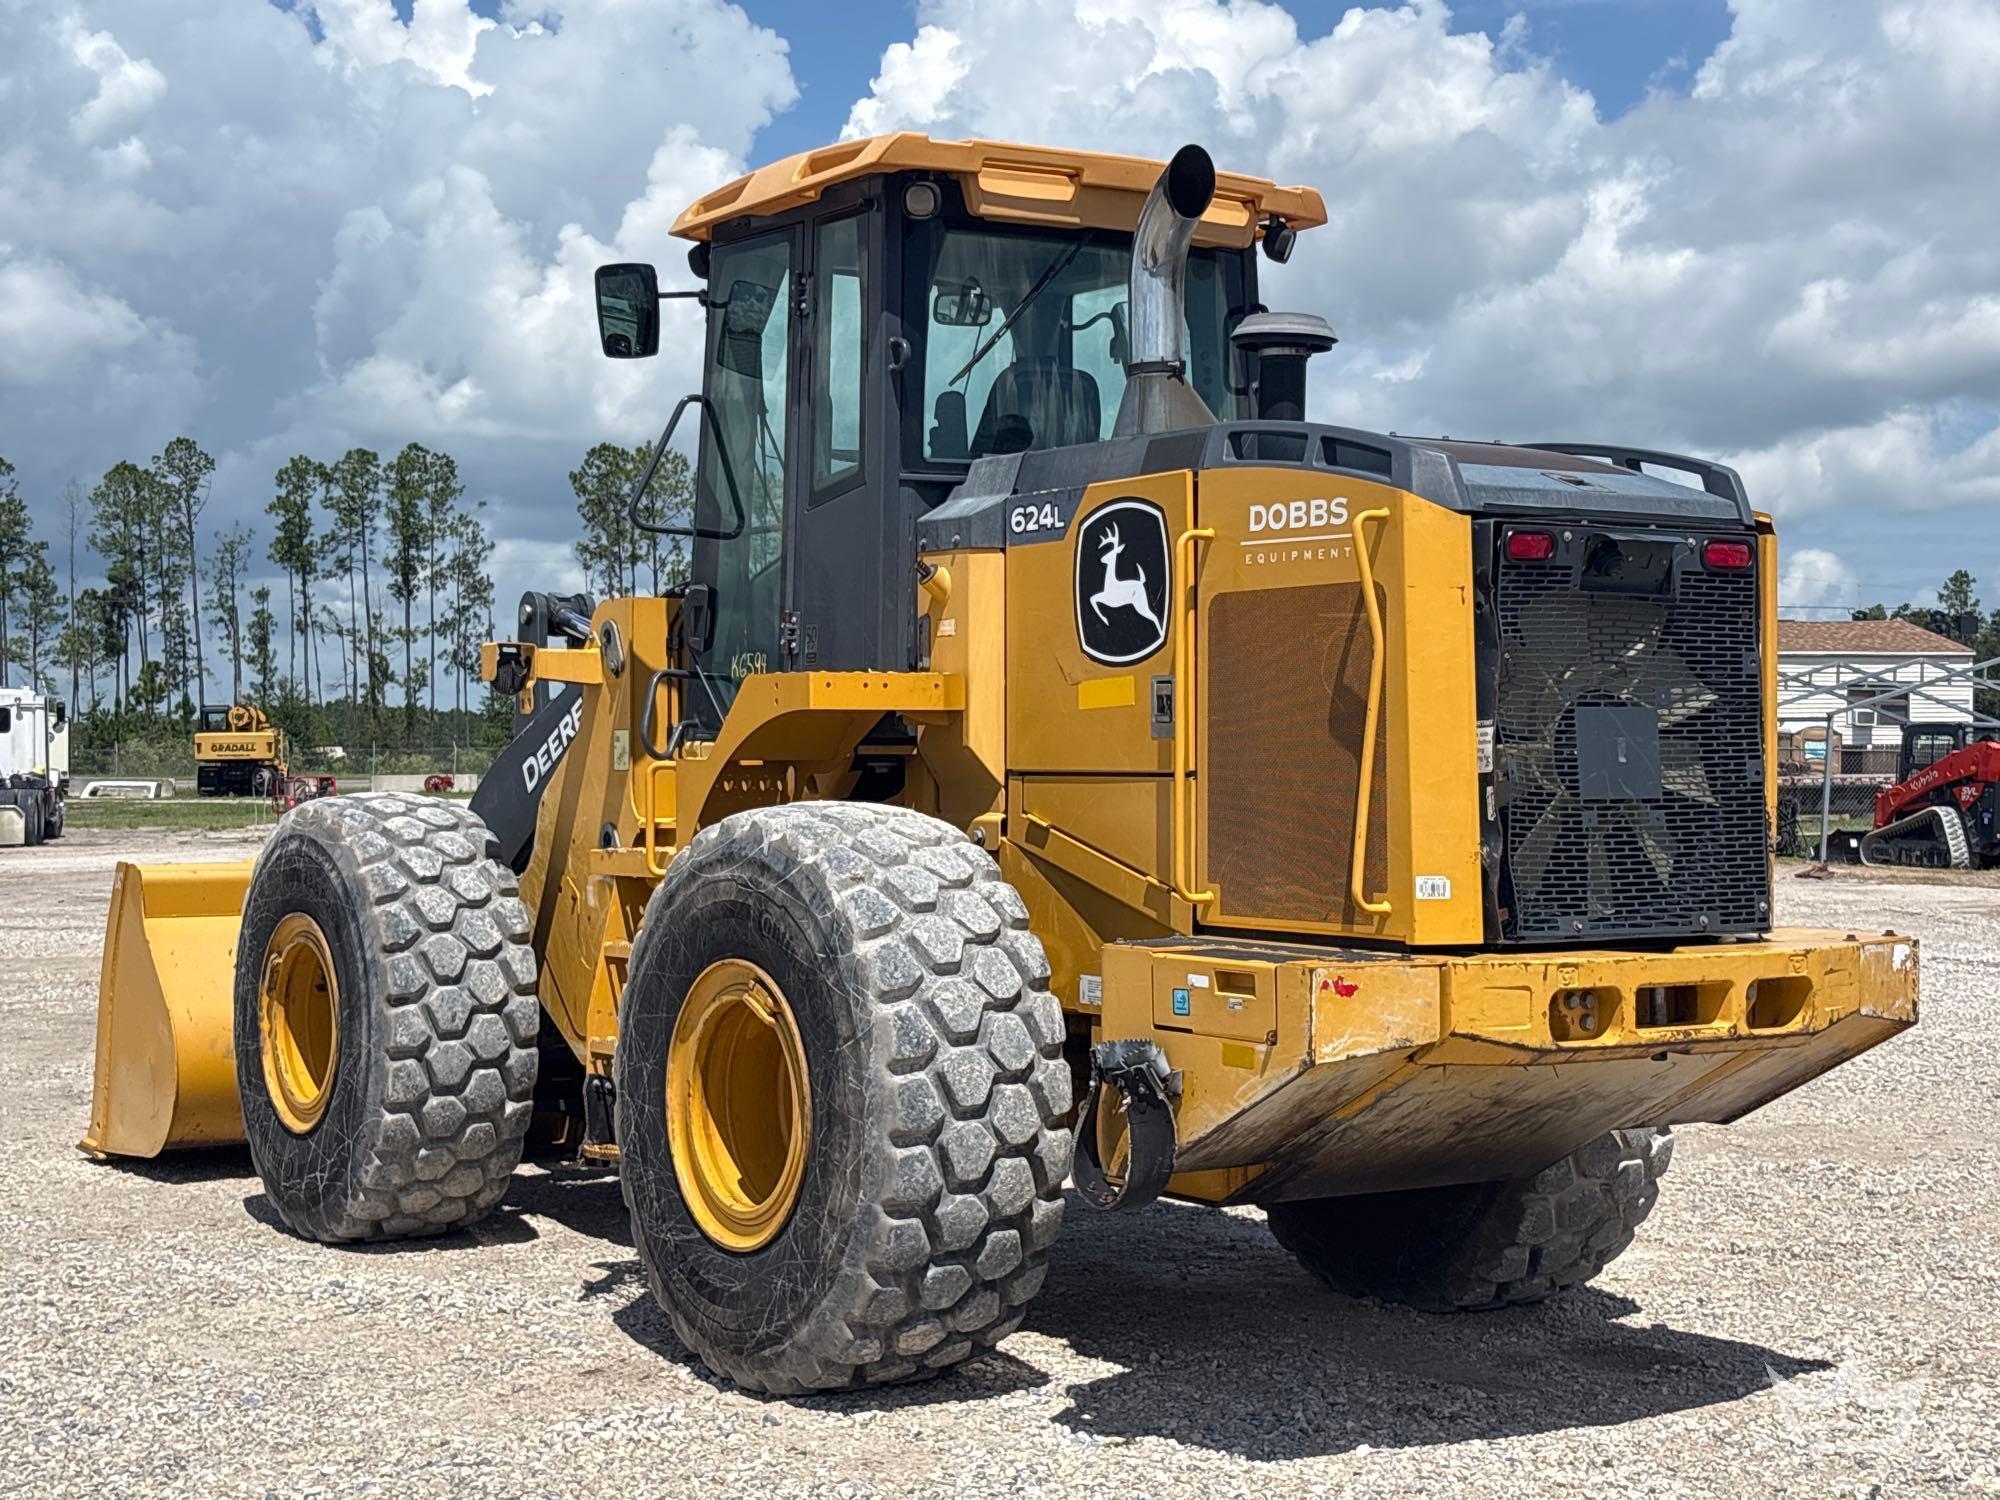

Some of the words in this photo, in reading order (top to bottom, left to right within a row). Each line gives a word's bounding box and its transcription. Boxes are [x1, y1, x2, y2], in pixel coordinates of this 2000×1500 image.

[1010, 503, 1065, 533] 624L
[1249, 497, 1349, 532] DOBBS
[1245, 547, 1351, 565] EQUIPMENT
[211, 744, 257, 753] GRADALL
[522, 697, 583, 794] DEERE
[1910, 770, 1938, 791] Kubota
[1961, 786, 1978, 796] SVL
